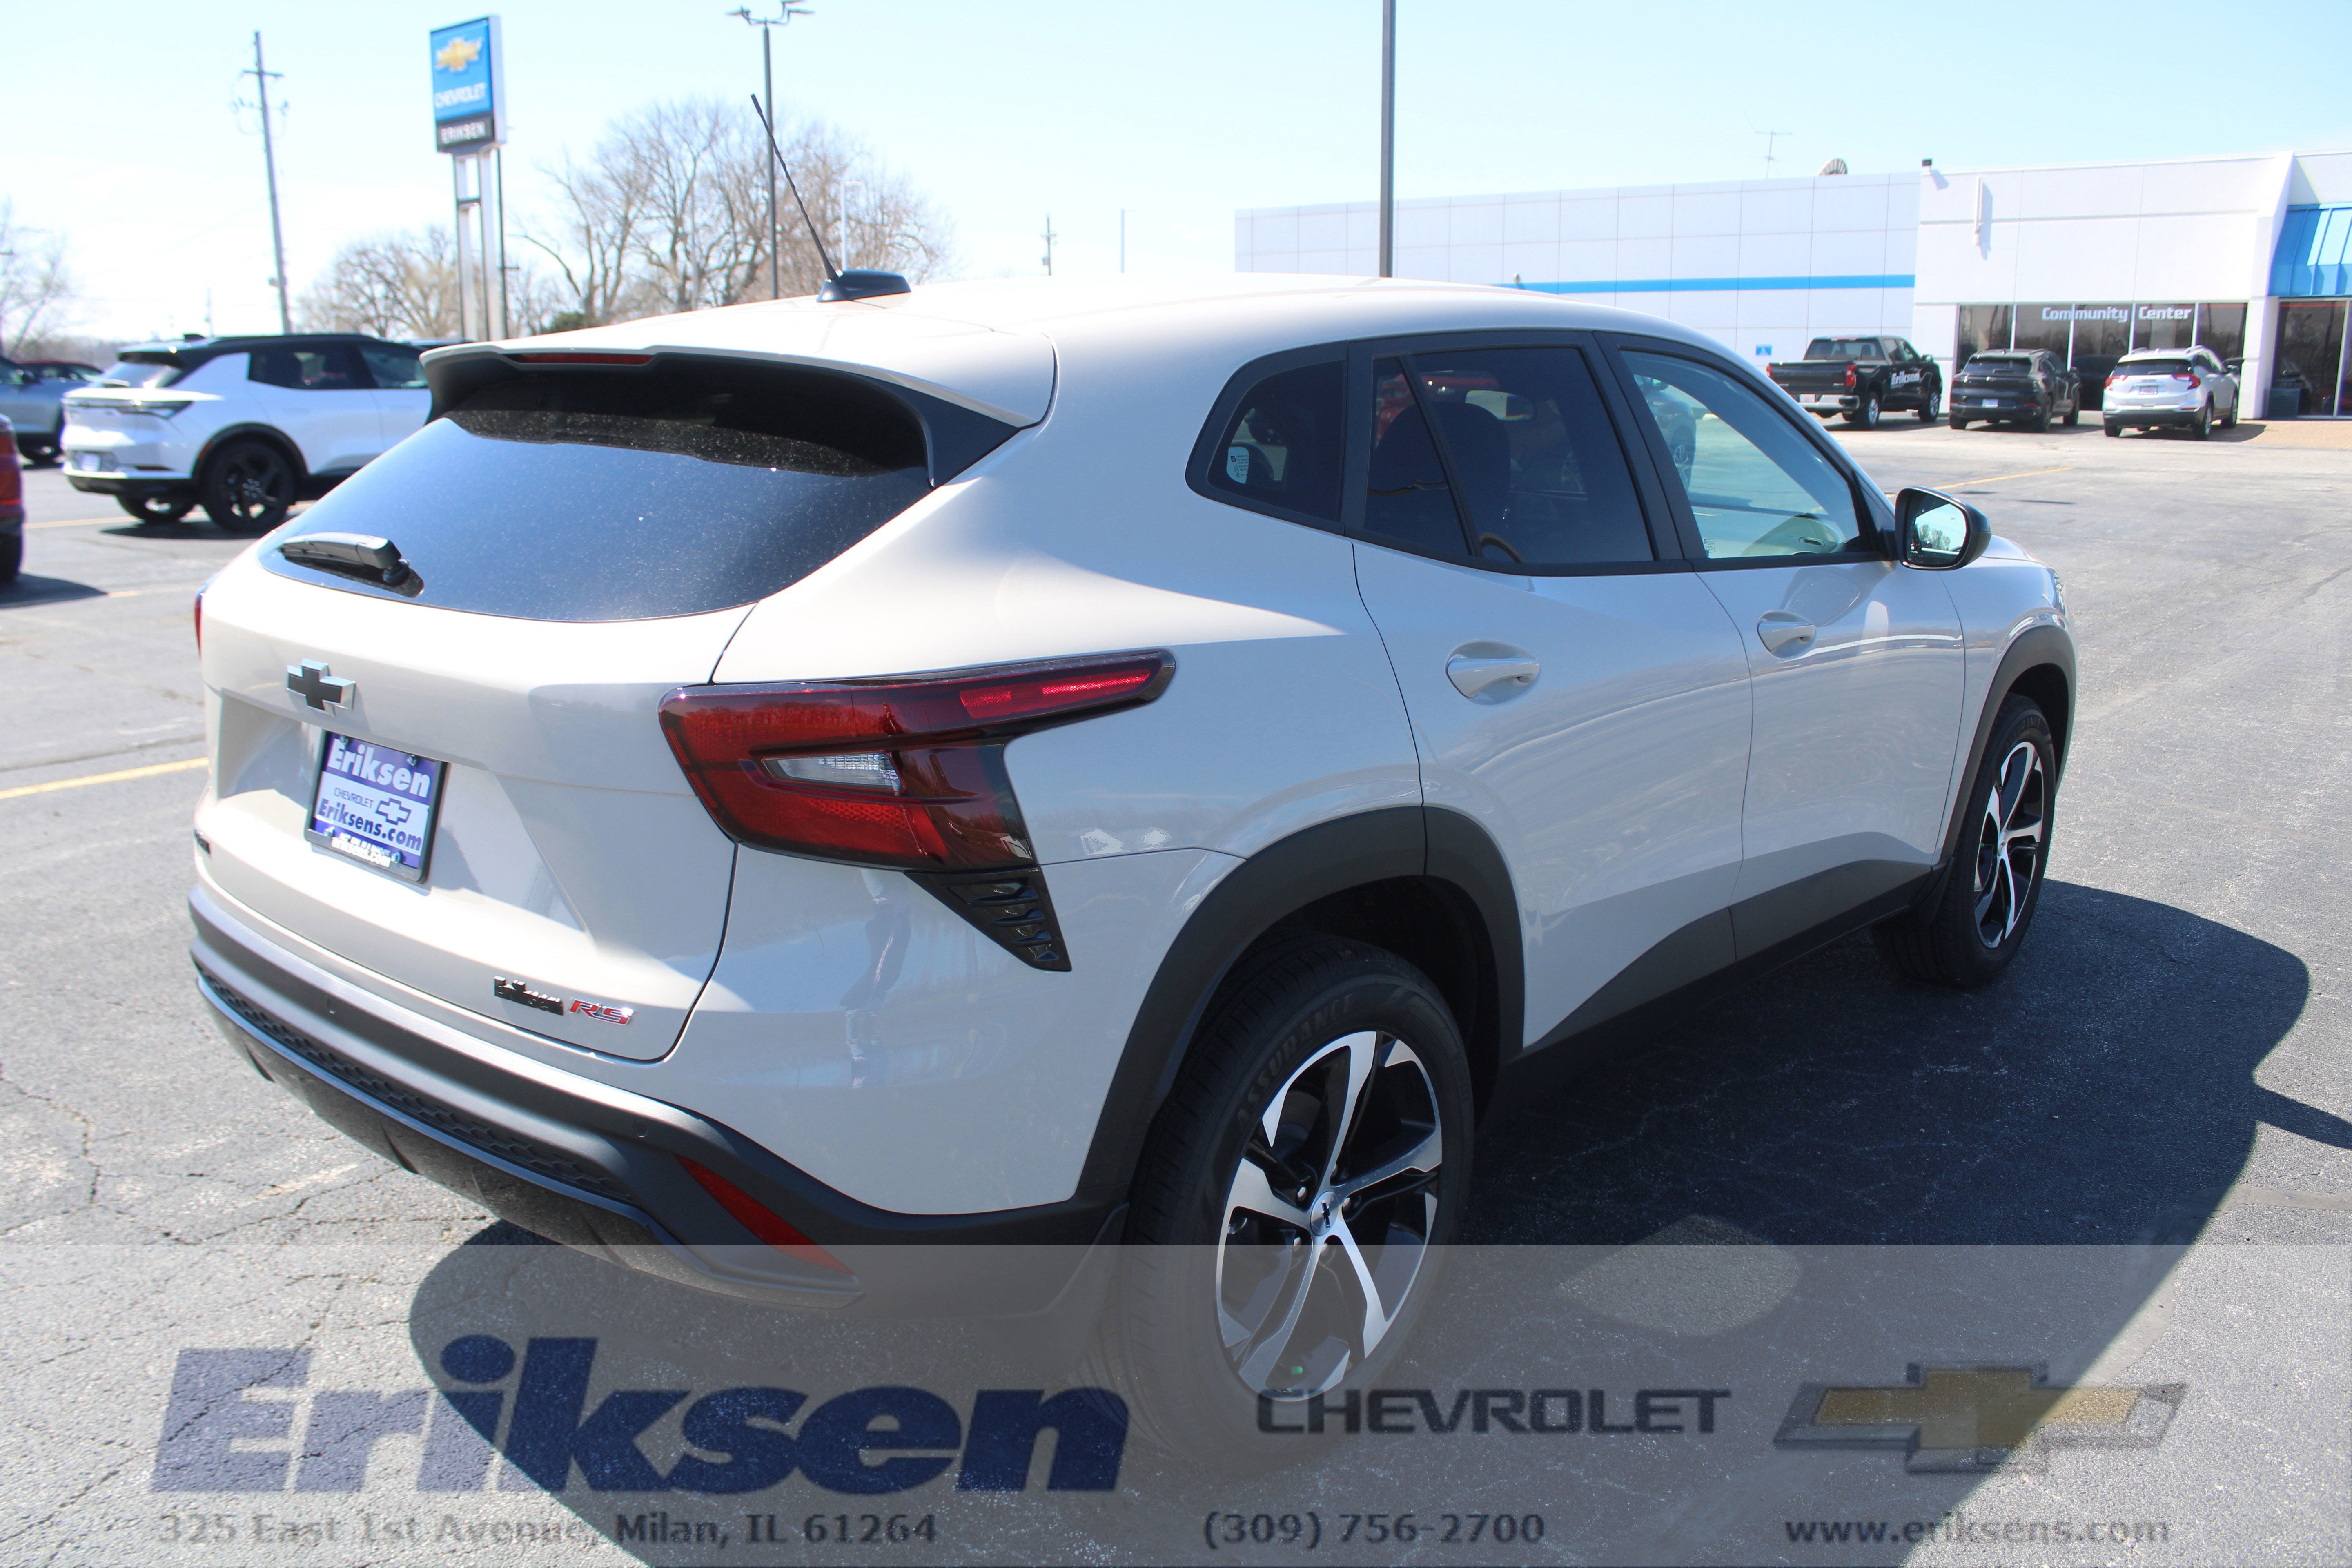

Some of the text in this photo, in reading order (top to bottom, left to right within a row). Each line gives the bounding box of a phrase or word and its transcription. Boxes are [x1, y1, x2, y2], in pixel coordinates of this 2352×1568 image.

[2042, 305, 2192, 323] Community Center
[327, 739, 430, 798] Eriksen
[334, 787, 374, 809] CHEVROLET
[318, 798, 422, 851] Eriksens.com
[568, 998, 635, 1025] RS
